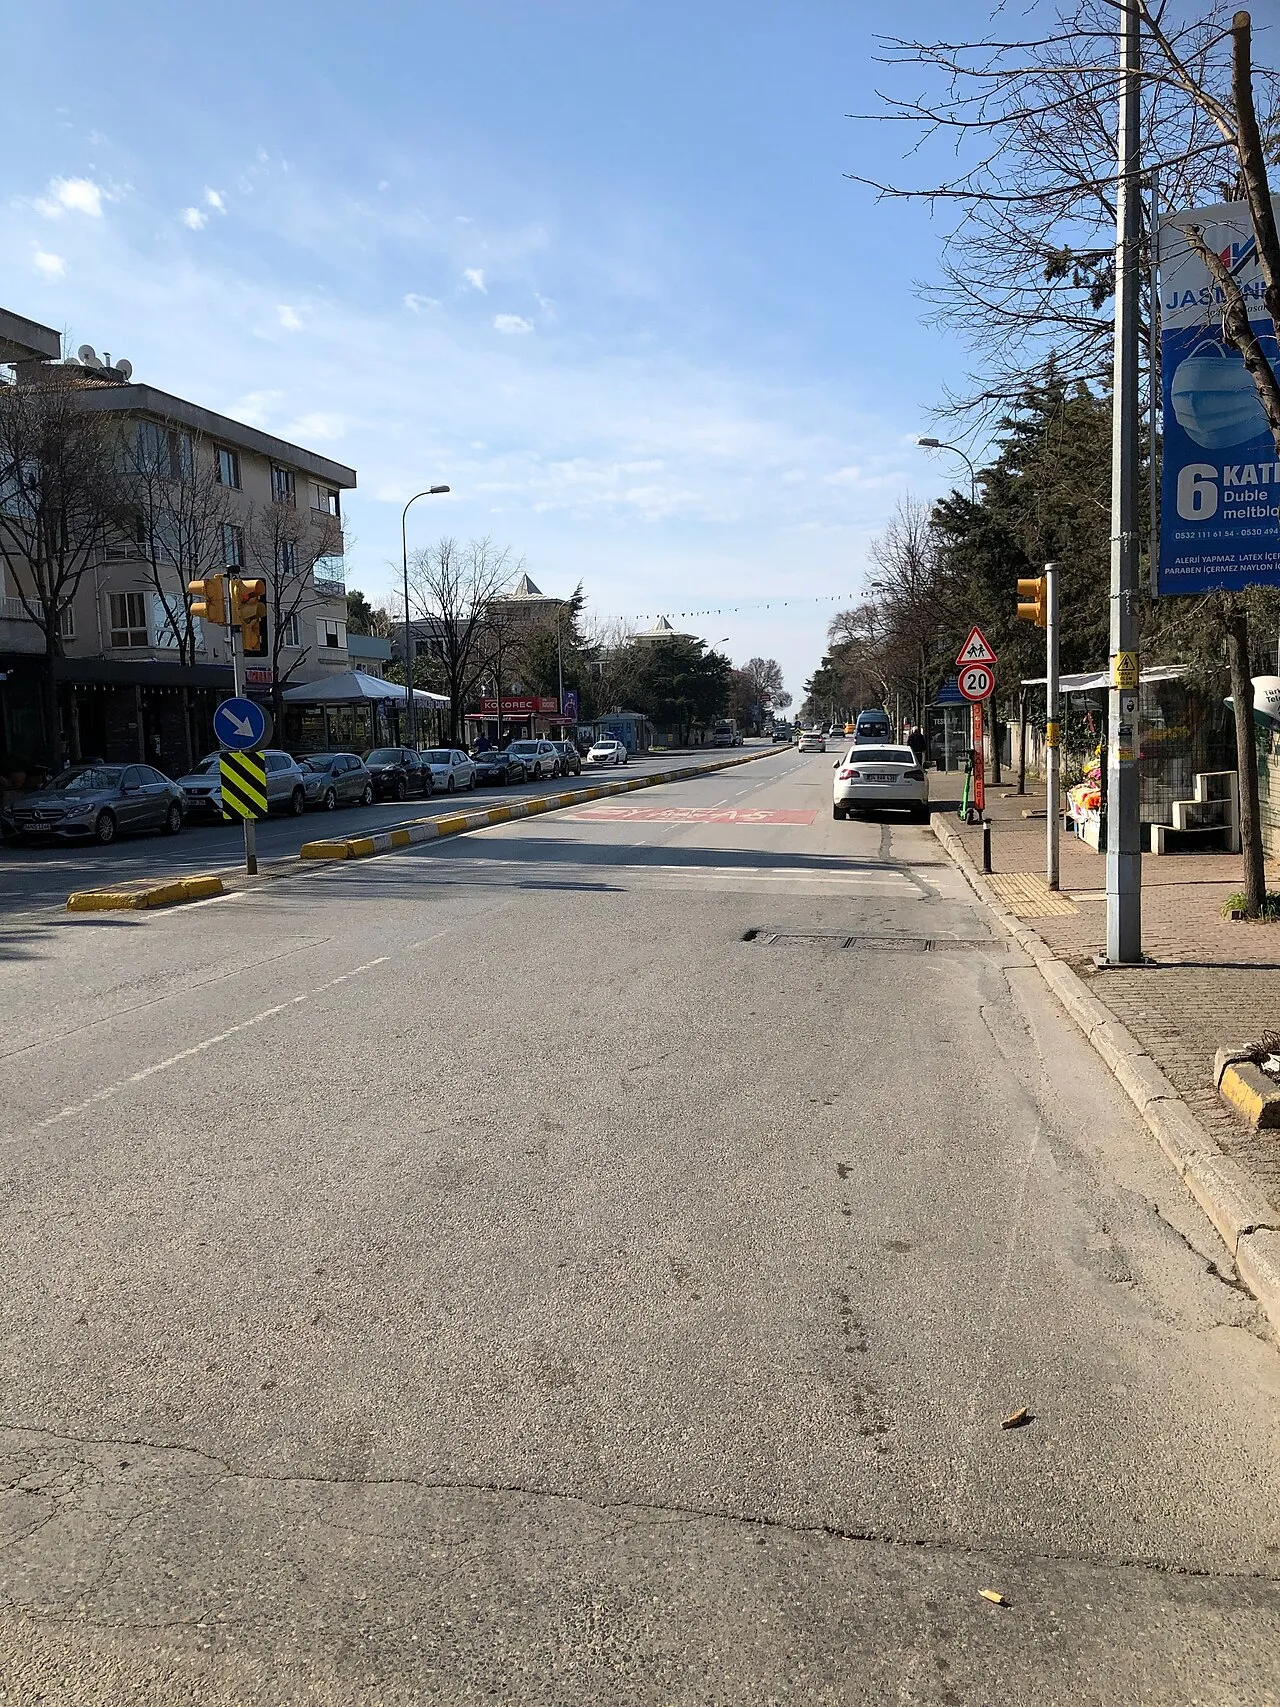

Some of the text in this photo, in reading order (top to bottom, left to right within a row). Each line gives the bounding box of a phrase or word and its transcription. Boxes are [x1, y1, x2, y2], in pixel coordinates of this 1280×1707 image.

[1177, 463, 1218, 520] 6
[1224, 489, 1268, 502] Duble
[1223, 505, 1280, 519] meltblo
[1175, 531, 1195, 540] 0532
[1213, 530, 1222, 538] 61
[1241, 528, 1262, 536] 0530
[1264, 527, 1279, 535] 494
[1175, 554, 1200, 565] ALERJİ
[1201, 554, 1235, 563] YAPMAZ
[1239, 553, 1263, 561] LATEX
[1164, 566, 1201, 575] PARABEN
[1203, 565, 1238, 574] İÇERMEZ
[1240, 563, 1273, 571] NAYLON
[967, 673, 987, 690] 20
[1266, 695, 1280, 703] Tel
